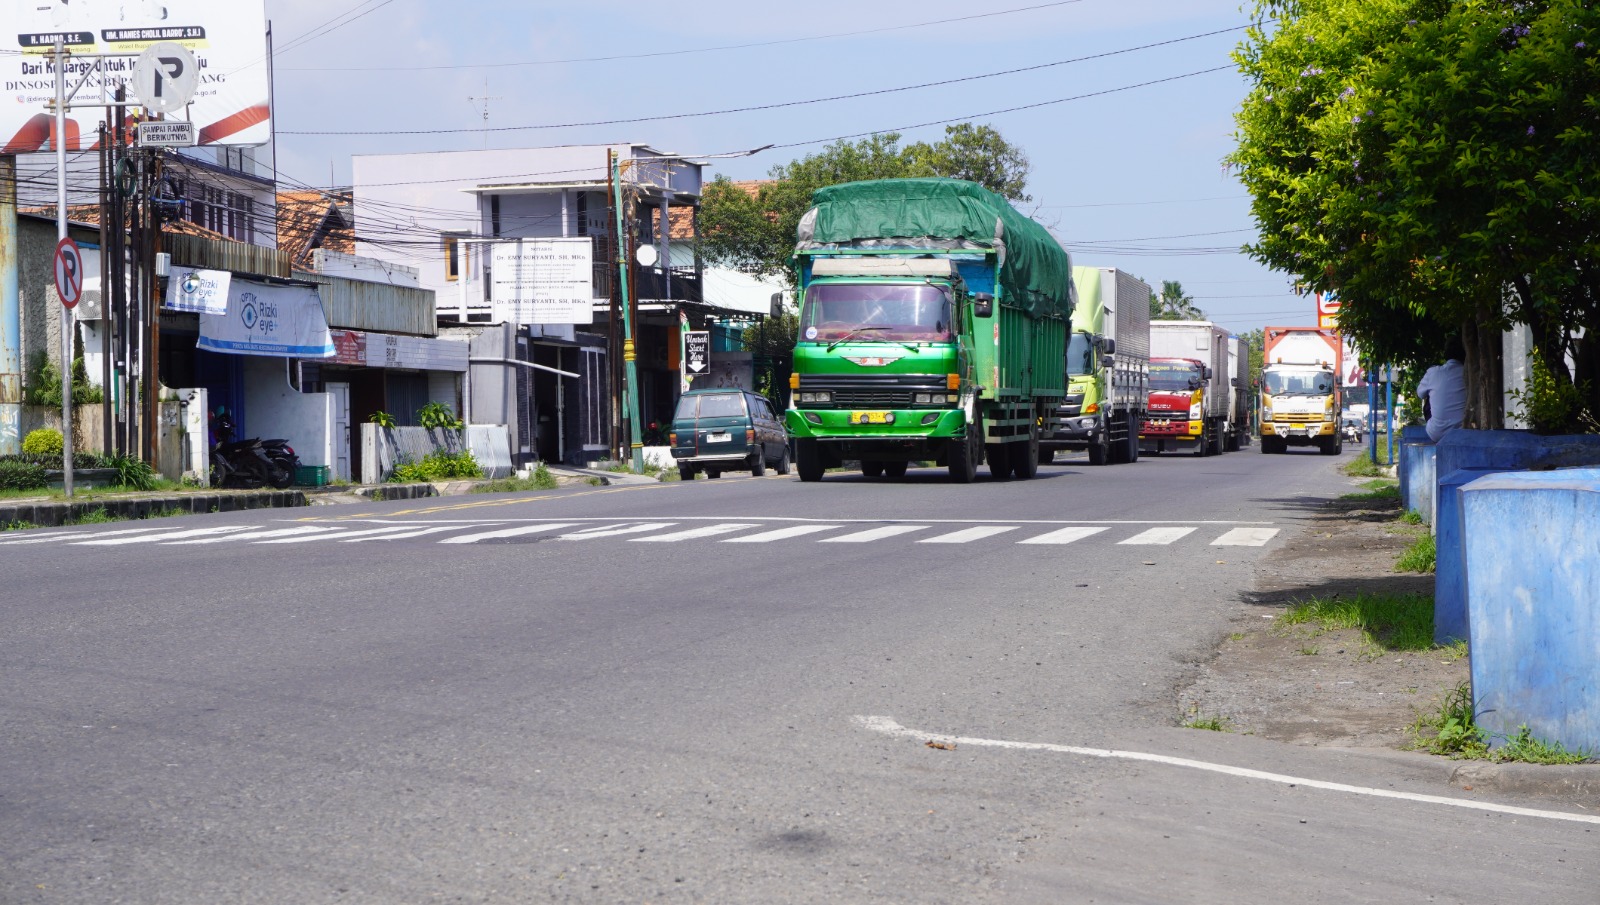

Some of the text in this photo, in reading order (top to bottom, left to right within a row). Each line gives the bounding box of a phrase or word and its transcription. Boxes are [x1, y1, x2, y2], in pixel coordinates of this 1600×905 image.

[31, 36, 38, 44] H.
[68, 34, 81, 42] S.E.
[105, 31, 118, 39] HM.
[120, 30, 140, 39] HANIES
[142, 29, 161, 38] CHOLIL
[22, 62, 42, 75] Dari
[143, 124, 190, 134] SAMPAI RAMBU
[146, 133, 187, 142] BERIKUTNYA
[200, 279, 218, 288] Rizki
[240, 292, 257, 304] OPTIK
[260, 302, 277, 318] Rizki
[686, 335, 708, 343] Umrah
[689, 344, 705, 352] Start
[690, 352, 704, 361] Here
